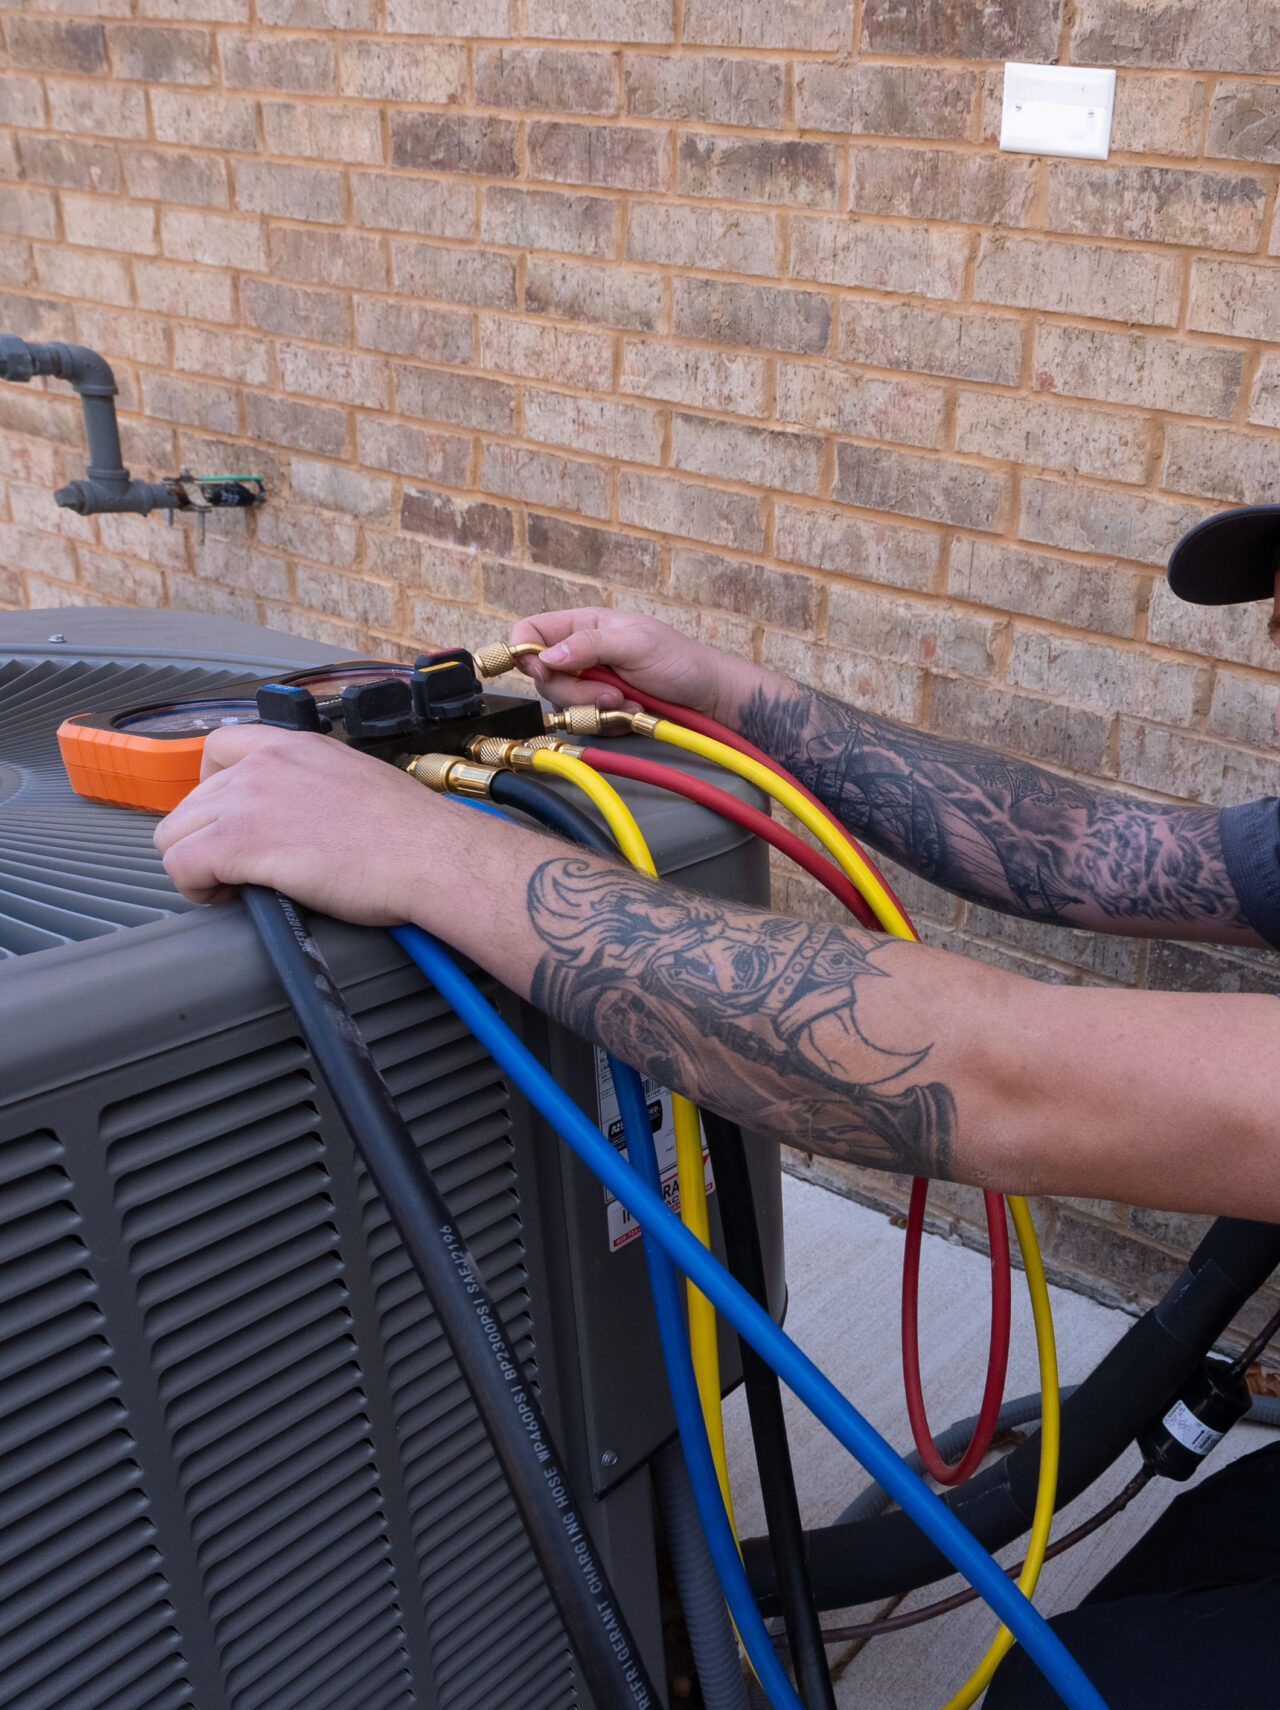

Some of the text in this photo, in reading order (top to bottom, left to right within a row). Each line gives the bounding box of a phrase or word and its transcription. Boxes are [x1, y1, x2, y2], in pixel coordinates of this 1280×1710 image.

[439, 1225, 652, 1710] REFRIGERANT CHARGING HOSE WP460PSI BP2300PSI SAEJ2196
